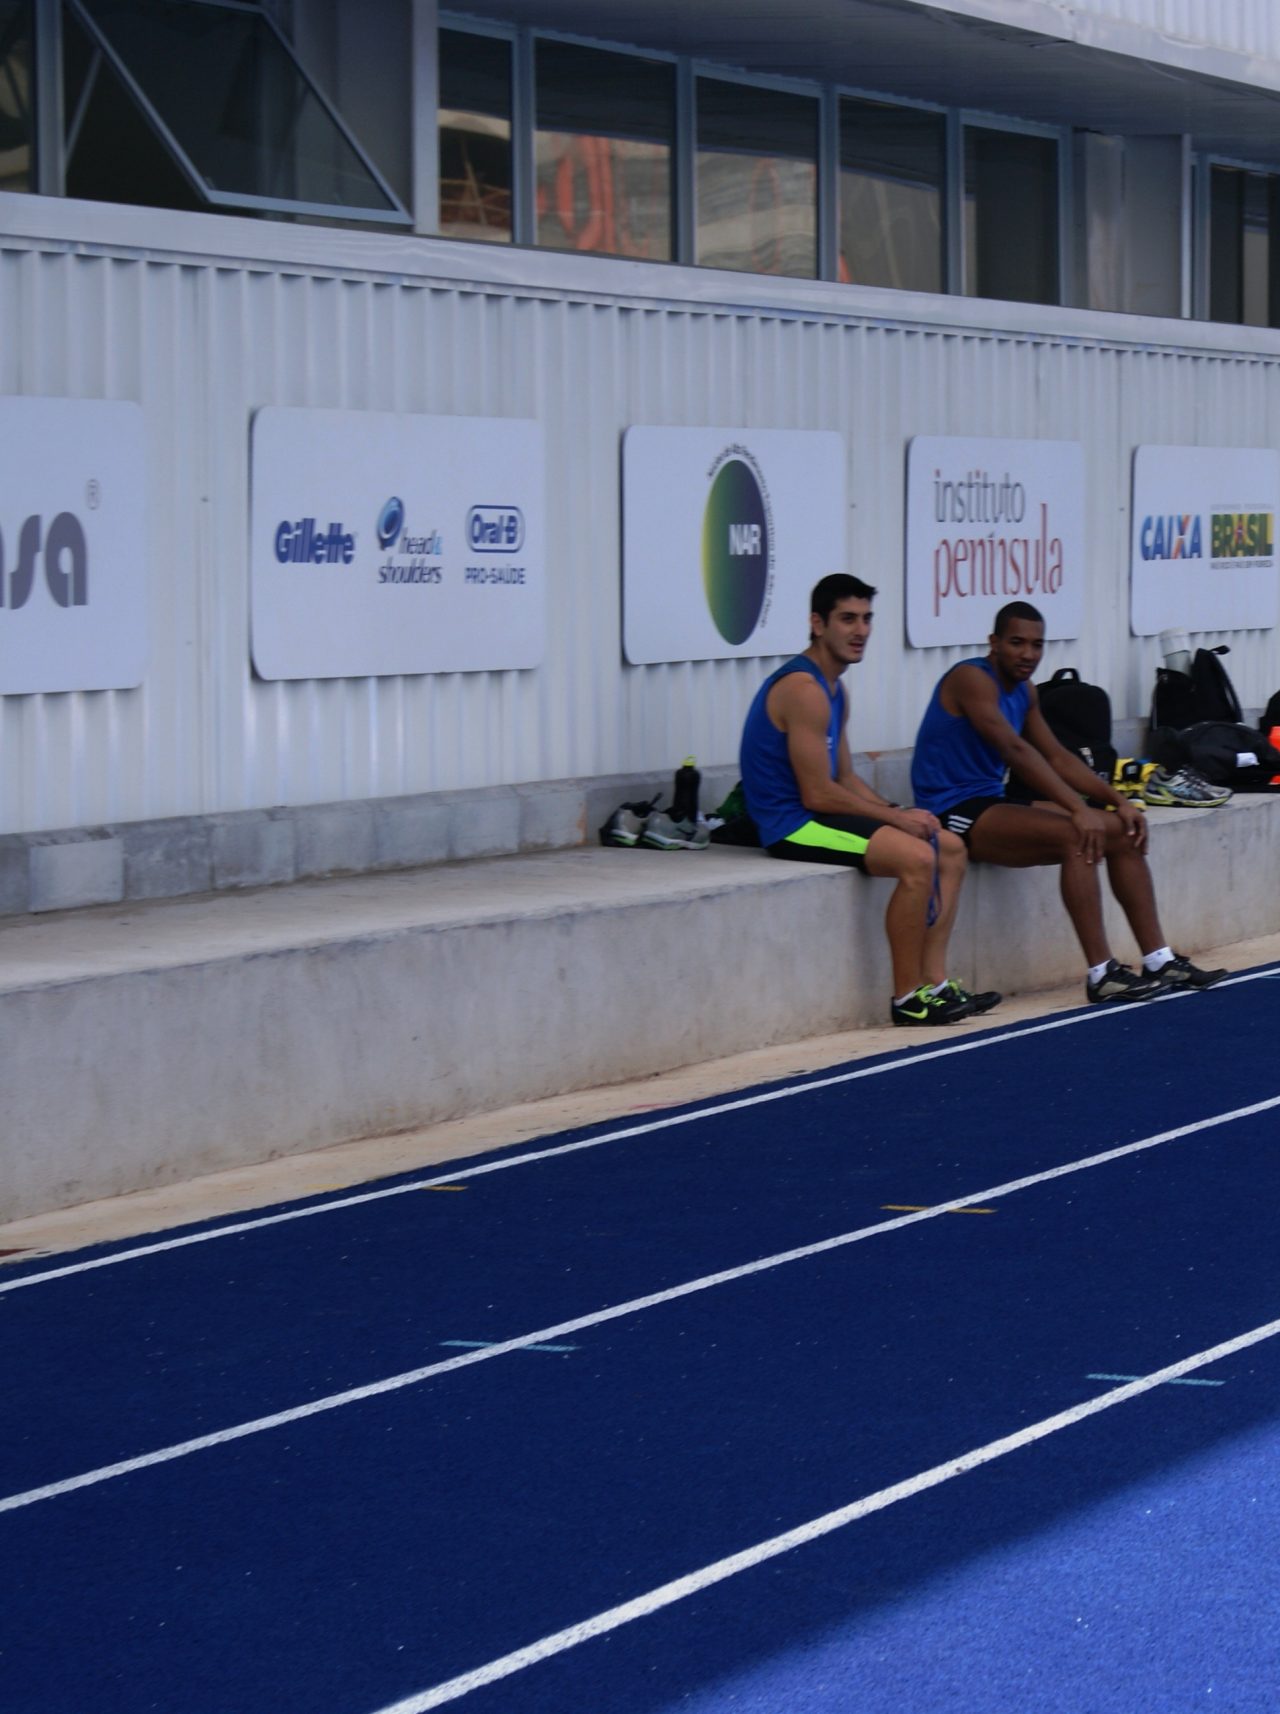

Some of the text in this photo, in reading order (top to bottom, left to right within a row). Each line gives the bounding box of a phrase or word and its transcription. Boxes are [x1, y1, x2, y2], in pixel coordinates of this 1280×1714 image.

[934, 468, 1026, 524] instituto
[274, 517, 355, 565] Gillette
[472, 513, 518, 545] Oral-B
[729, 523, 762, 555] NAR
[1140, 514, 1203, 561] CAIXA
[1211, 513, 1274, 558] BRASIL
[0, 511, 89, 610] sa
[378, 556, 443, 584] shoulders
[934, 502, 1064, 618] península
